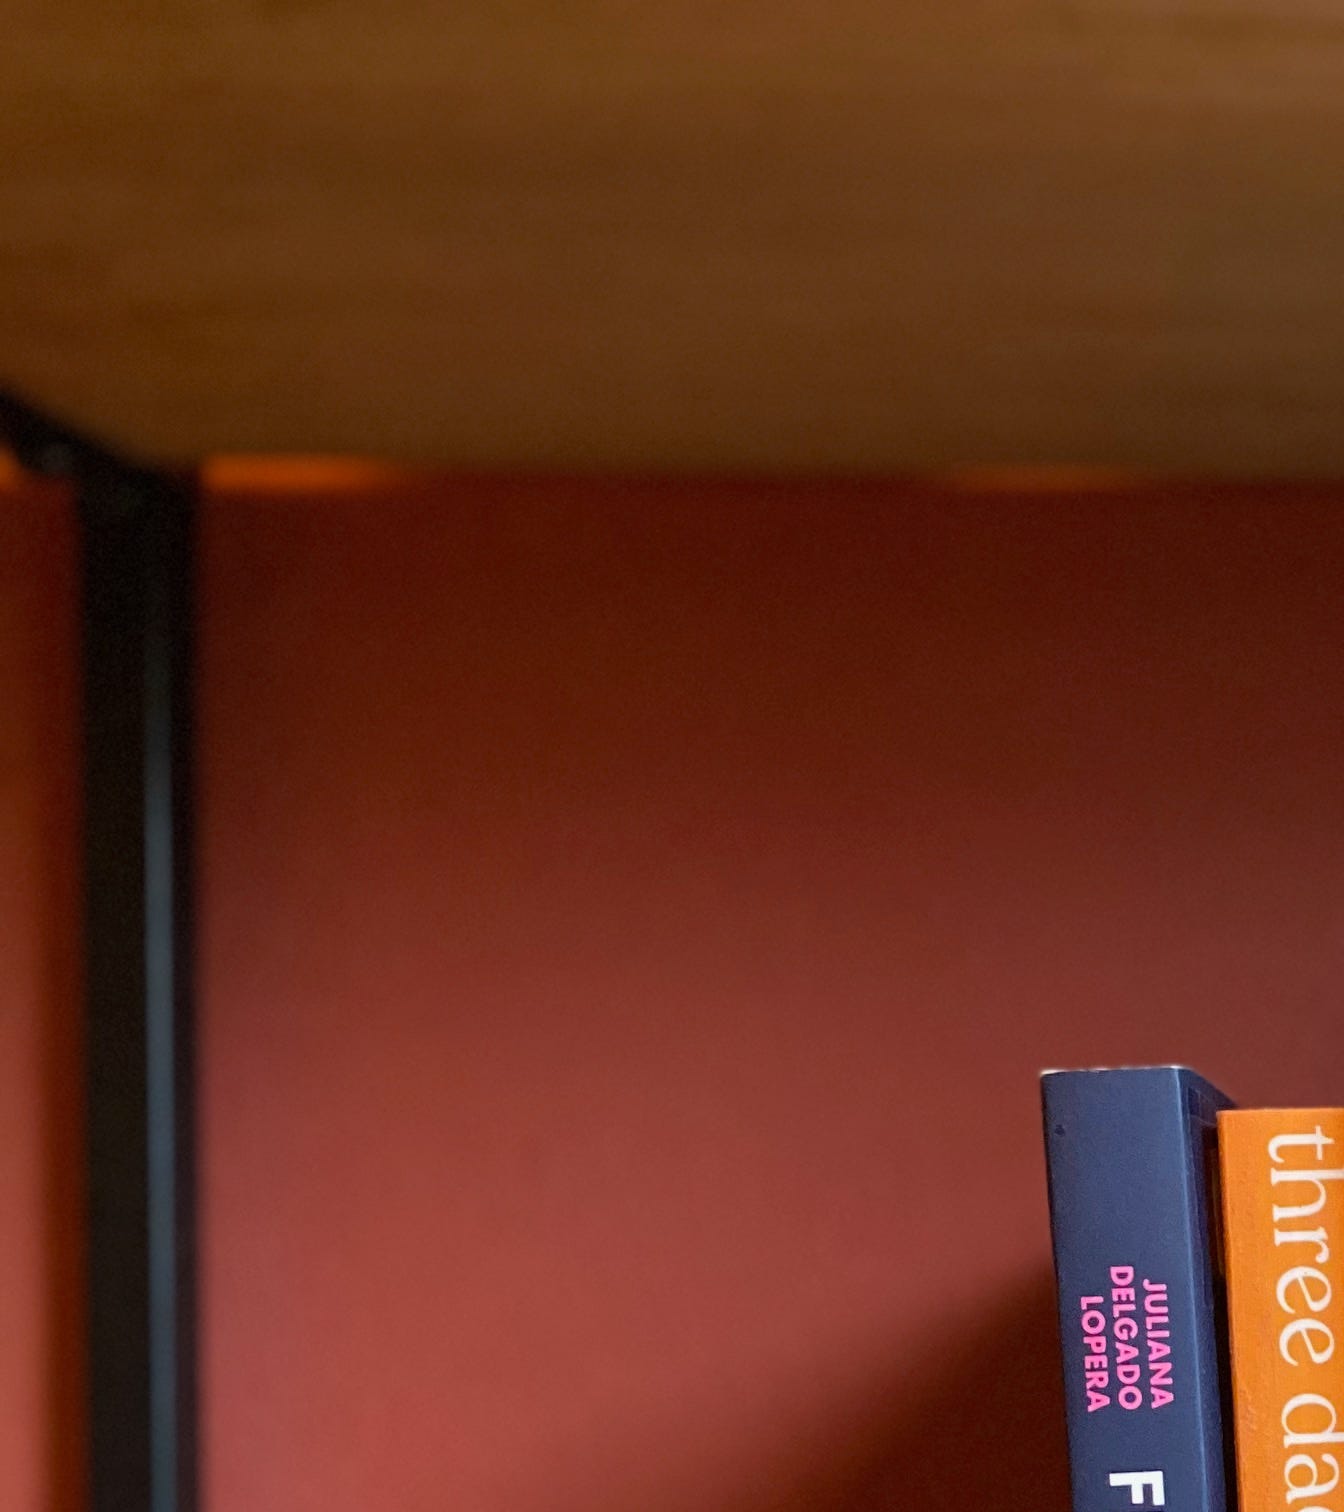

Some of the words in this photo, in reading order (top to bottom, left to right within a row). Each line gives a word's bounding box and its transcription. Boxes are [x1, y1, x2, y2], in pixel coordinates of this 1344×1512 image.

[1080, 1295, 1111, 1413] LOPERA
[1109, 1265, 1142, 1411] DELGADO
[1142, 1278, 1174, 1410] JULIANA
